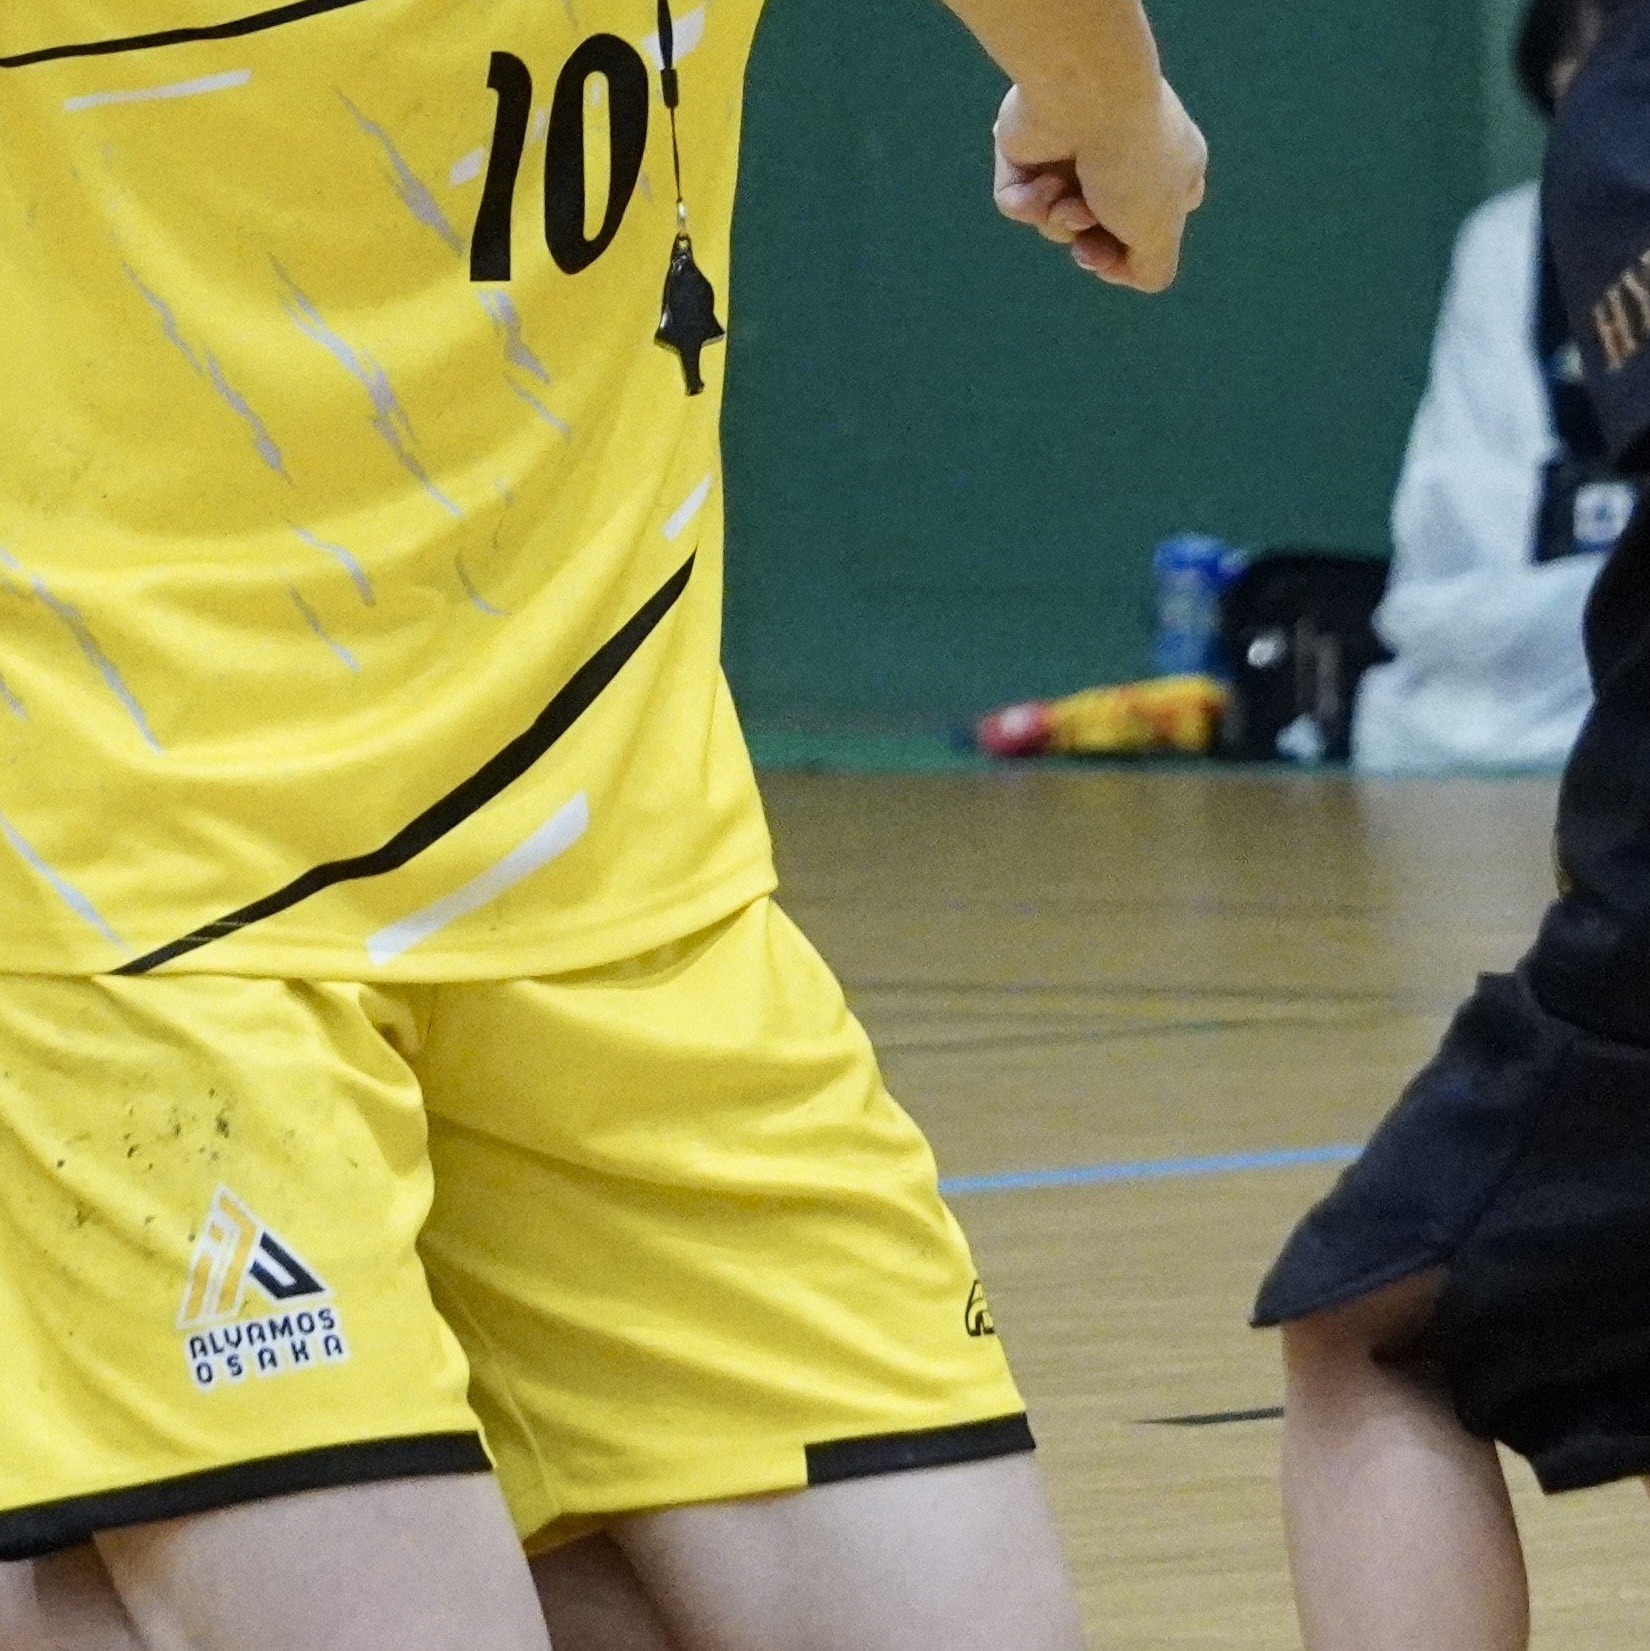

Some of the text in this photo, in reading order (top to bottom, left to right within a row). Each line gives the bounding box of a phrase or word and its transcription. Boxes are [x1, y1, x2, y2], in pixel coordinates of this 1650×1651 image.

[470, 32, 649, 275] 10
[189, 1307, 336, 1360] ALVAMOS
[196, 1334, 344, 1385] OSAKA
